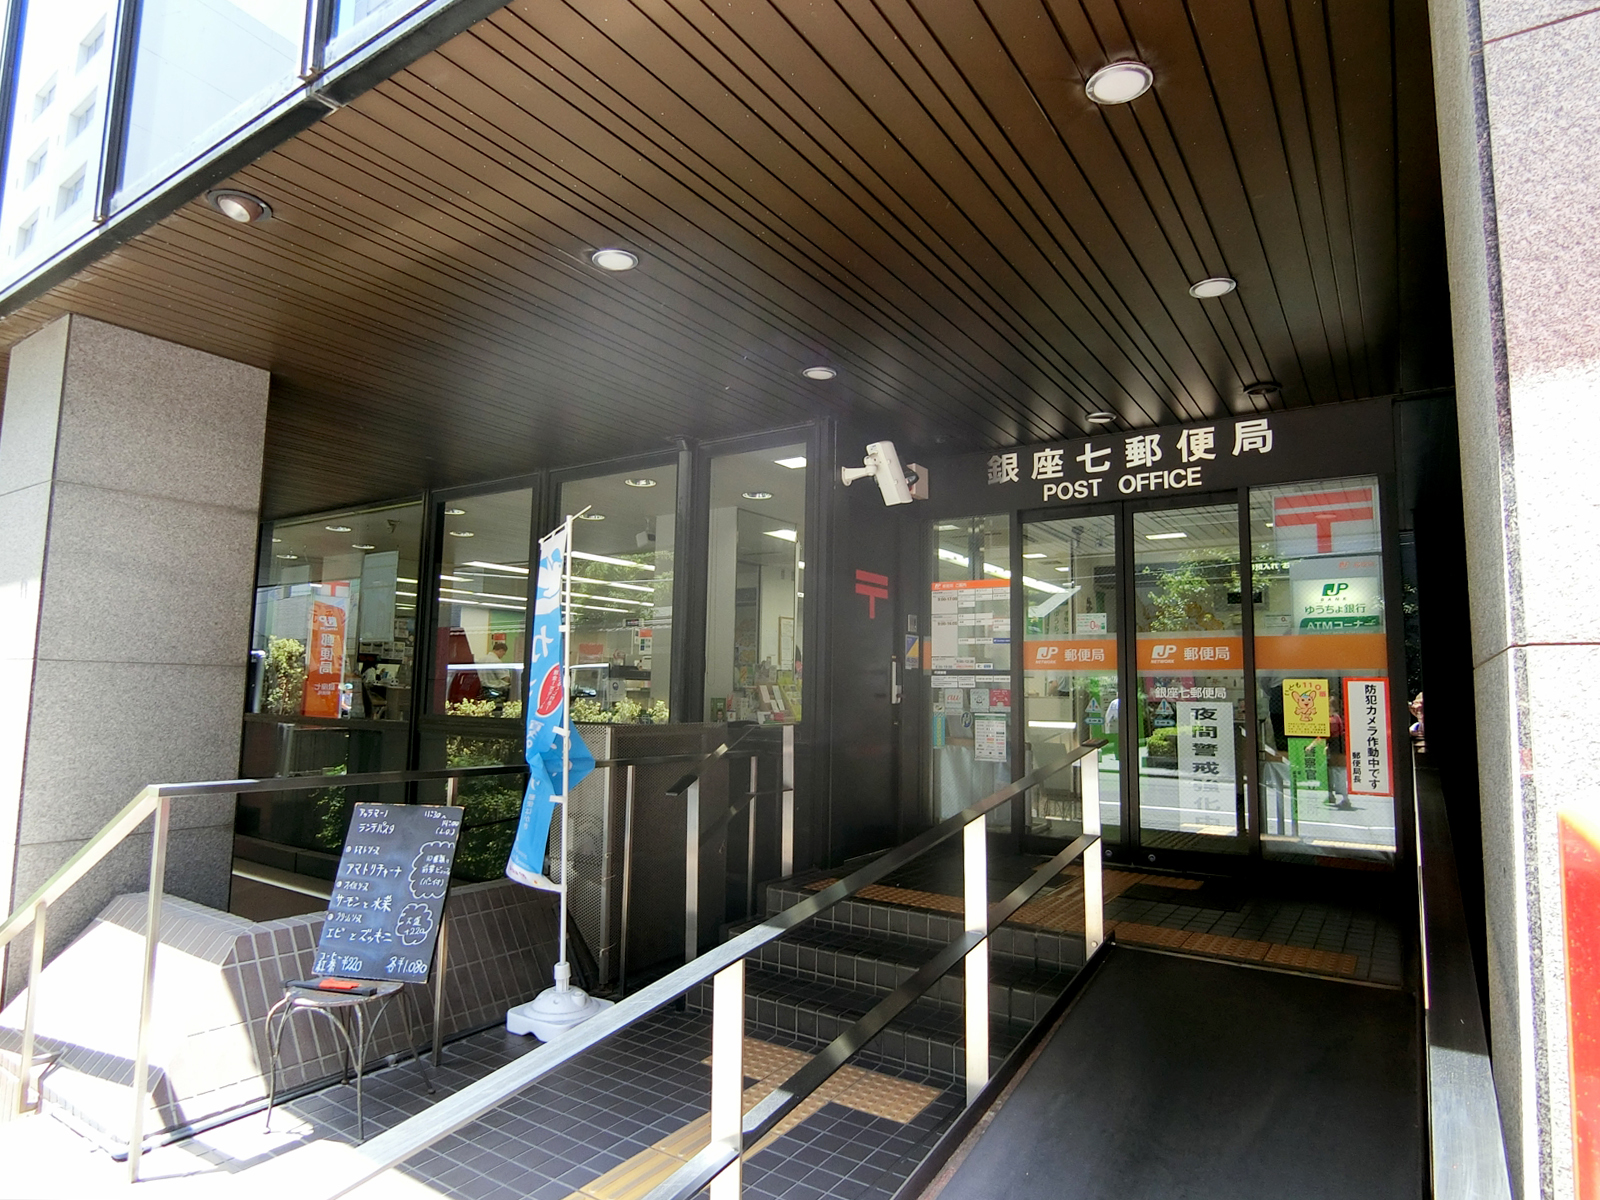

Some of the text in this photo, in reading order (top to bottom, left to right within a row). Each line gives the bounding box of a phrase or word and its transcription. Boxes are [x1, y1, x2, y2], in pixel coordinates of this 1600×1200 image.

[987, 418, 1273, 485] 銀座七郵便局
[1043, 466, 1202, 501] POST OFFICE
[1322, 582, 1349, 597] JP
[1304, 603, 1366, 616] ゆうちょ銀行
[1306, 618, 1376, 631] ATMコーナー
[1036, 646, 1105, 662] JP 郵便局
[1152, 645, 1230, 661] JP 郵便局
[1155, 686, 1227, 700] 銀座七郵便局
[1364, 684, 1381, 790] 防犯カメラ作動中です
[1352, 751, 1362, 784] 郵便局長
